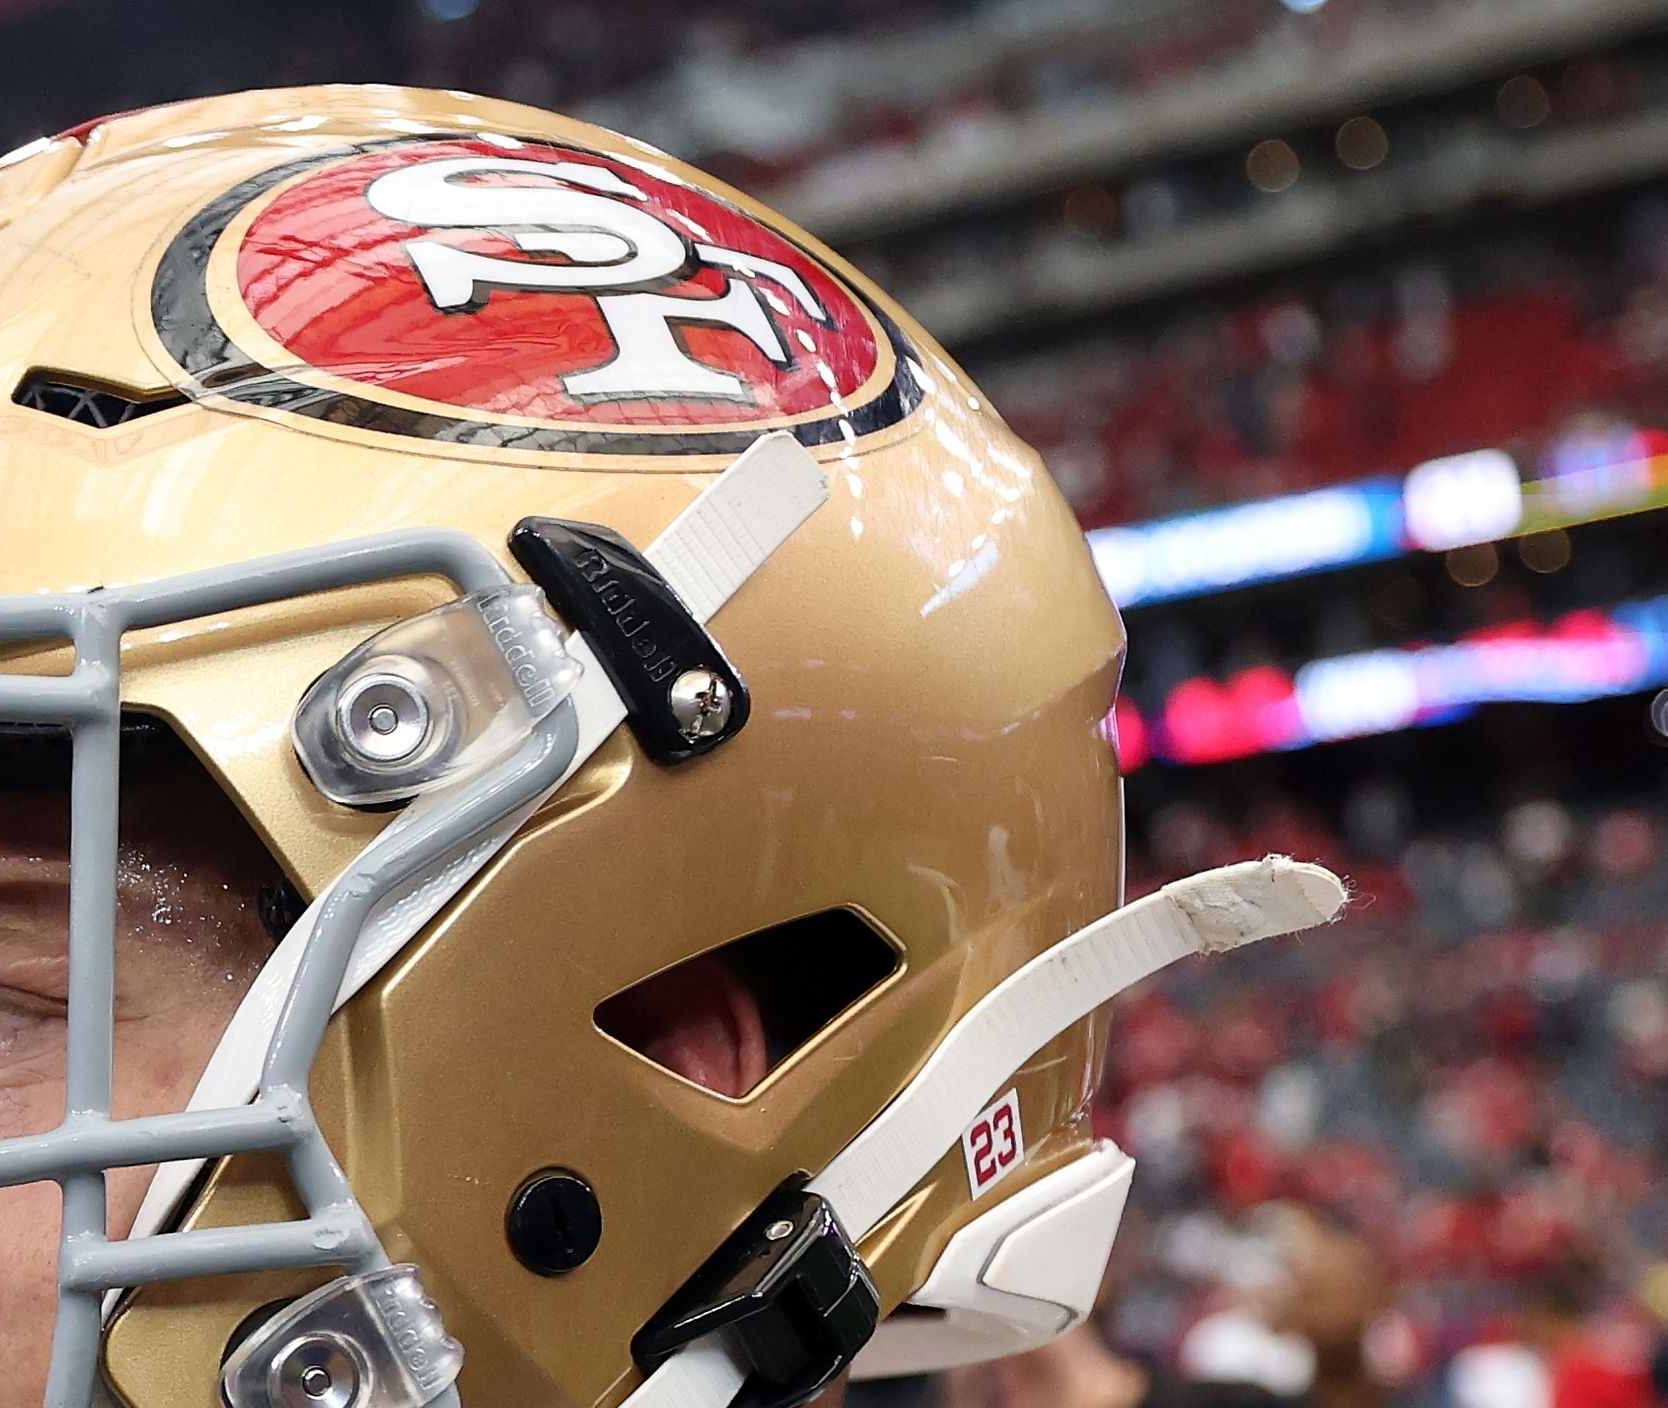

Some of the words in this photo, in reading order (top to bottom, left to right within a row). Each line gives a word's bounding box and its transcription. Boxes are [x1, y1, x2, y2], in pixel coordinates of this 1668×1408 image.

[365, 156, 836, 404] SF
[573, 550, 680, 683] Riddell
[969, 1102, 1018, 1188] 23
